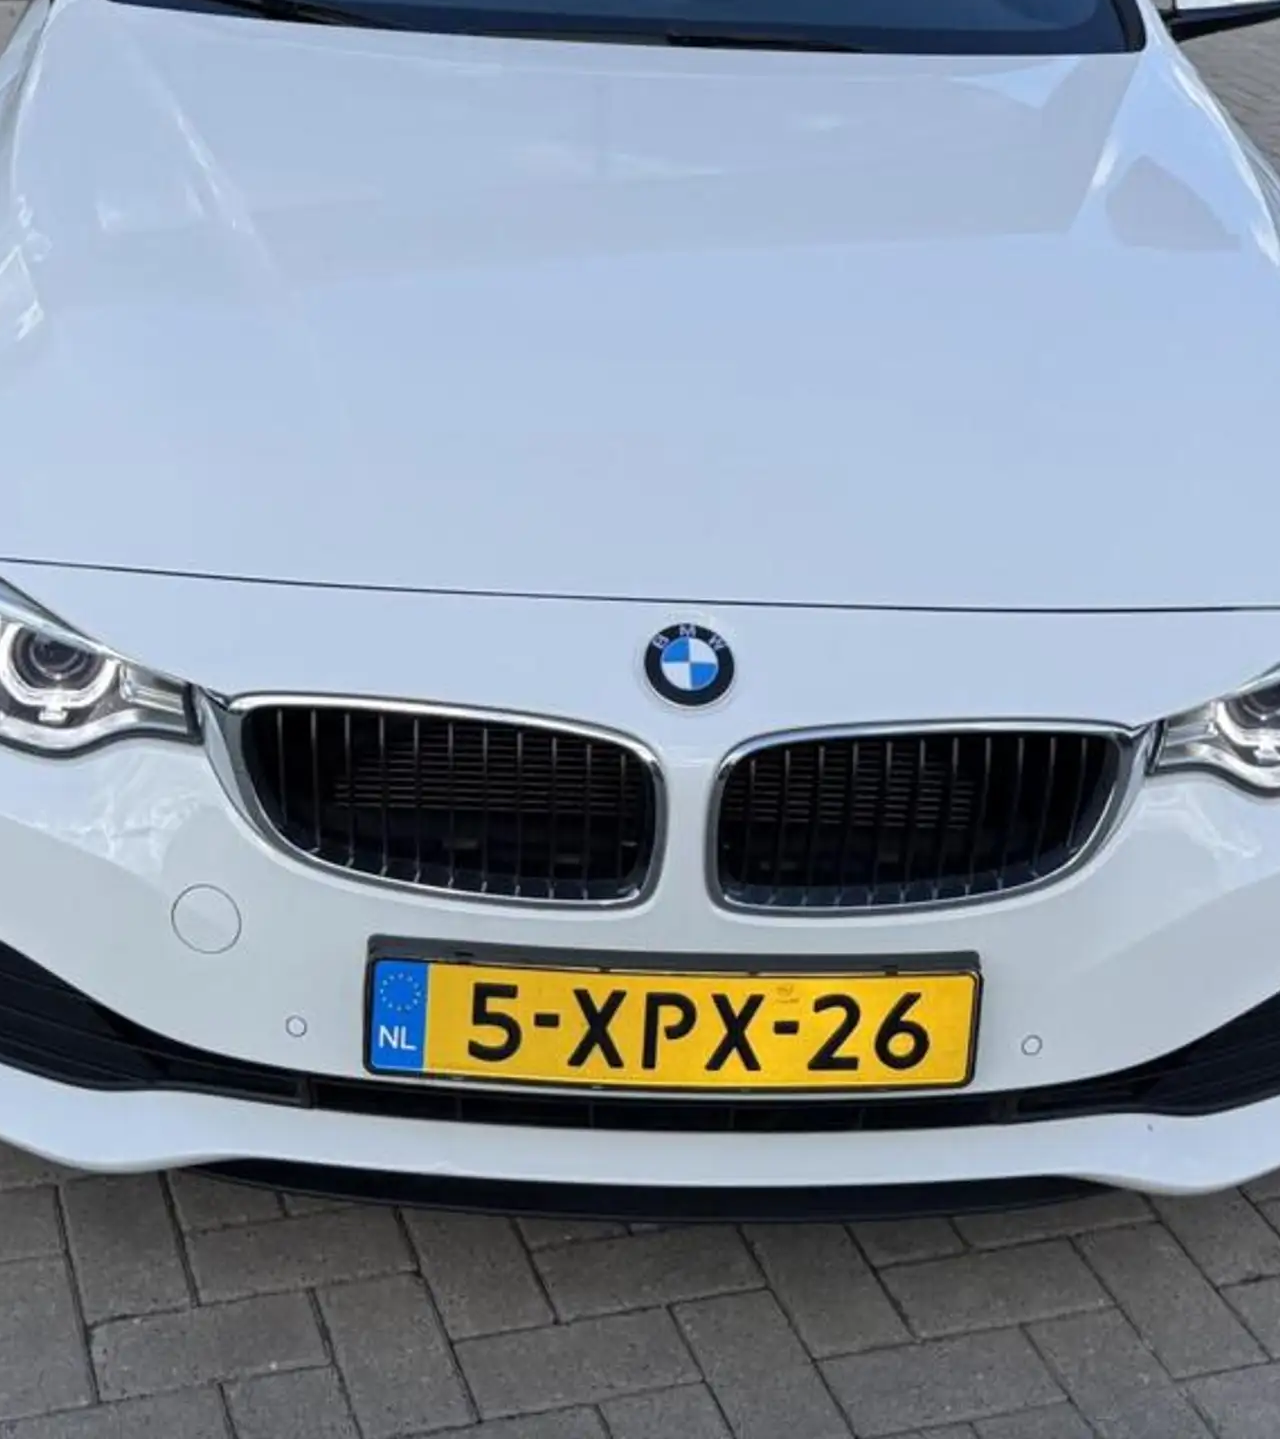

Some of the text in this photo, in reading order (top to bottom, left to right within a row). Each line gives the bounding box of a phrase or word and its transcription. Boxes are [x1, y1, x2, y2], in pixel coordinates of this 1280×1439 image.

[652, 622, 727, 651] BMW
[379, 1024, 418, 1051] NL
[467, 981, 931, 1072] 5-XPX-26
